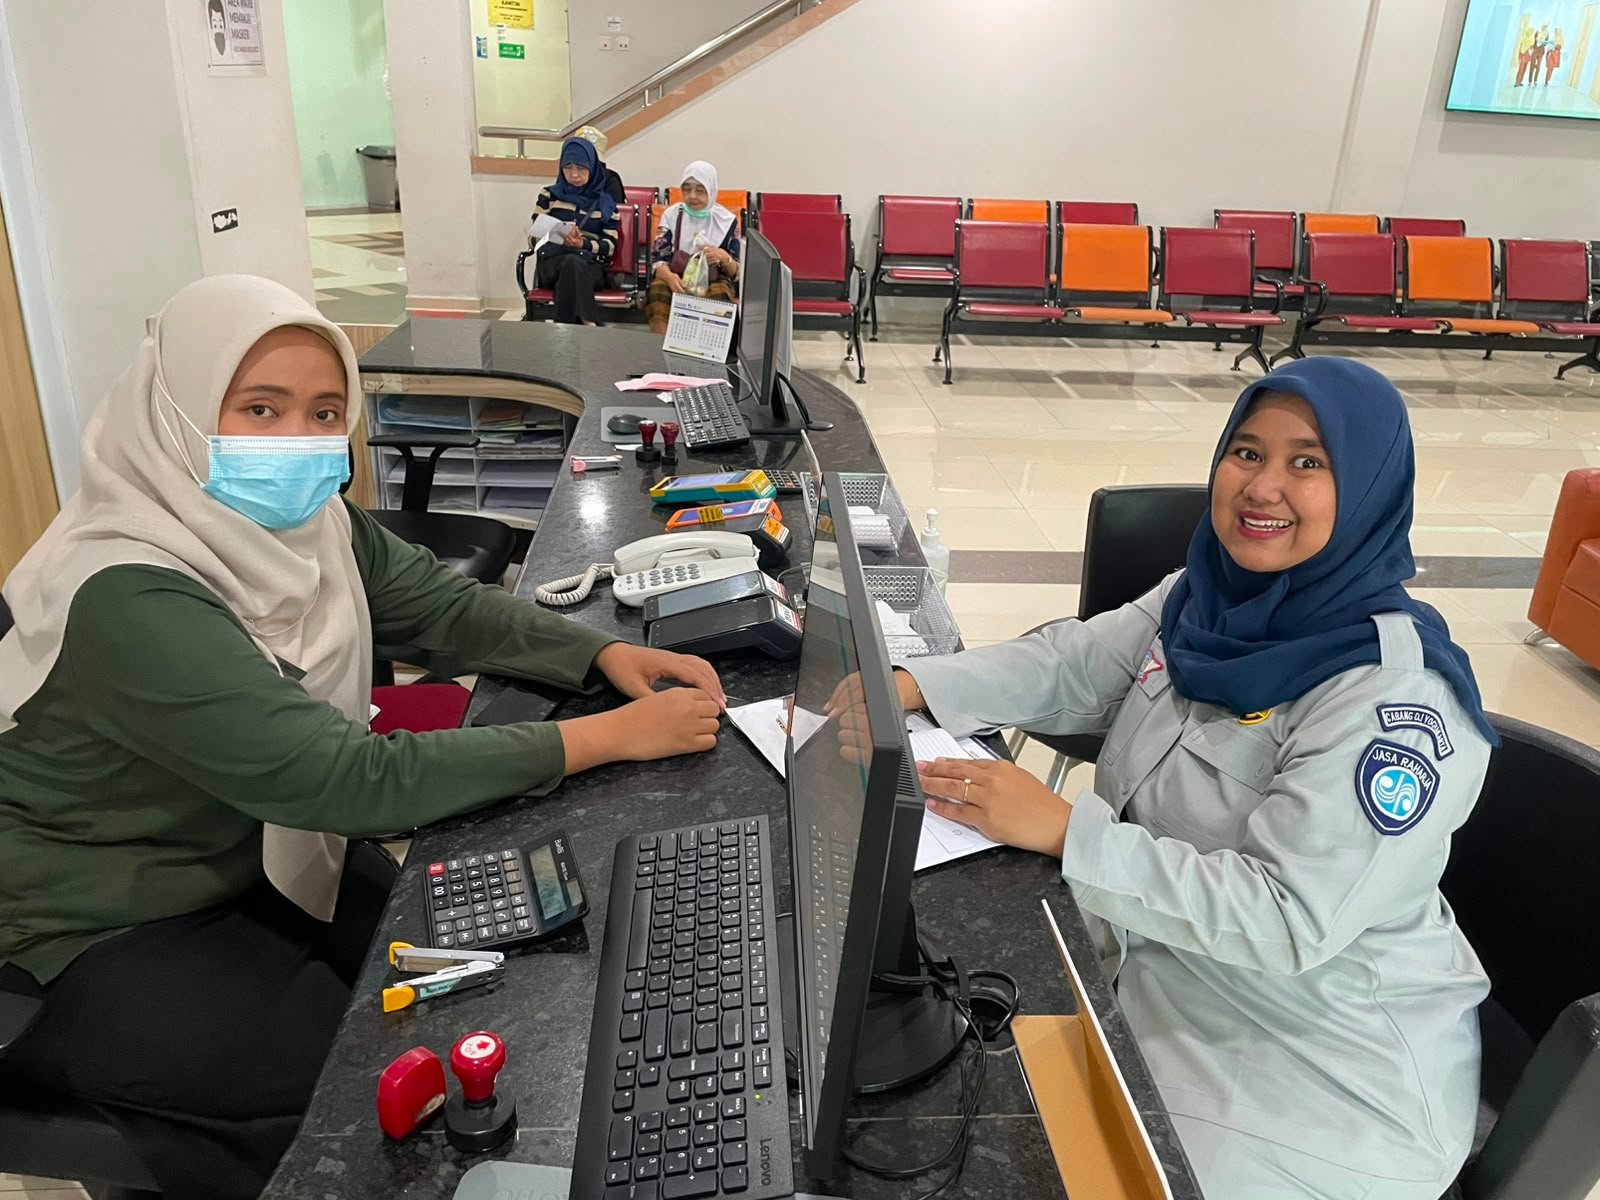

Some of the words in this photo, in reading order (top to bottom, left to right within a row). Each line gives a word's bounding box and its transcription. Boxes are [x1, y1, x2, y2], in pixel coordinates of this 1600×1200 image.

[1386, 710, 1414, 722] CABANG
[1372, 750, 1398, 764] JASA
[1400, 756, 1432, 792] RAHARJA
[434, 886, 444, 895] 00
[761, 1138, 772, 1186] Lenovo
